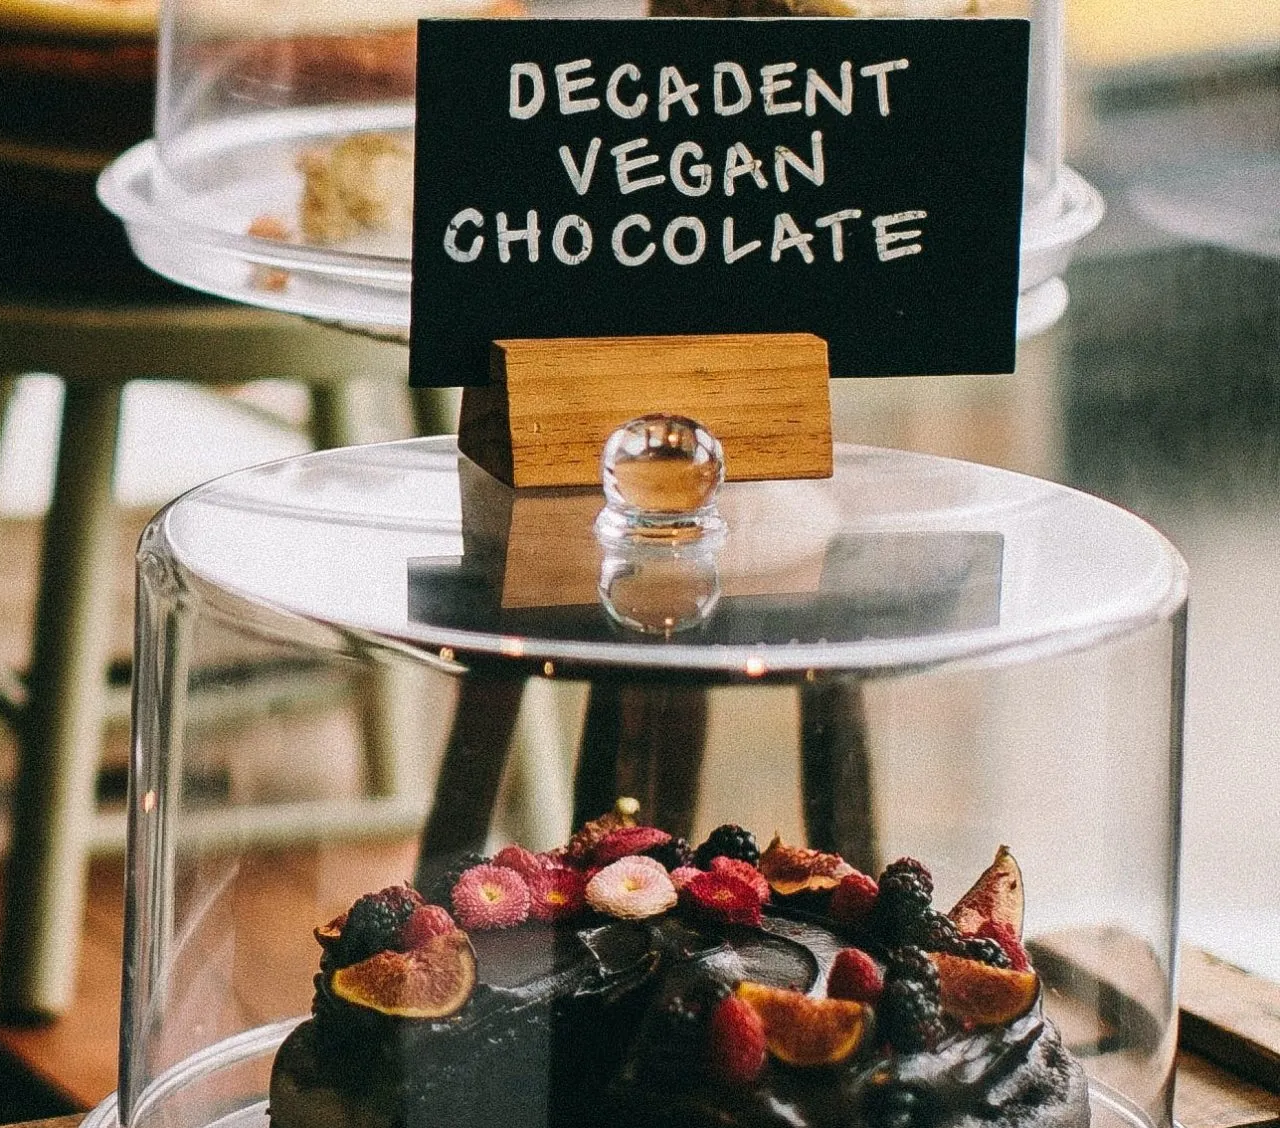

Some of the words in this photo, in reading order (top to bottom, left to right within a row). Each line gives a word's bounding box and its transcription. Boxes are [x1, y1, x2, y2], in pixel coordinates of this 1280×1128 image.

[508, 58, 909, 122] DECADENT
[558, 130, 825, 196] VEGAN
[443, 208, 927, 267] CHOCOLATE
